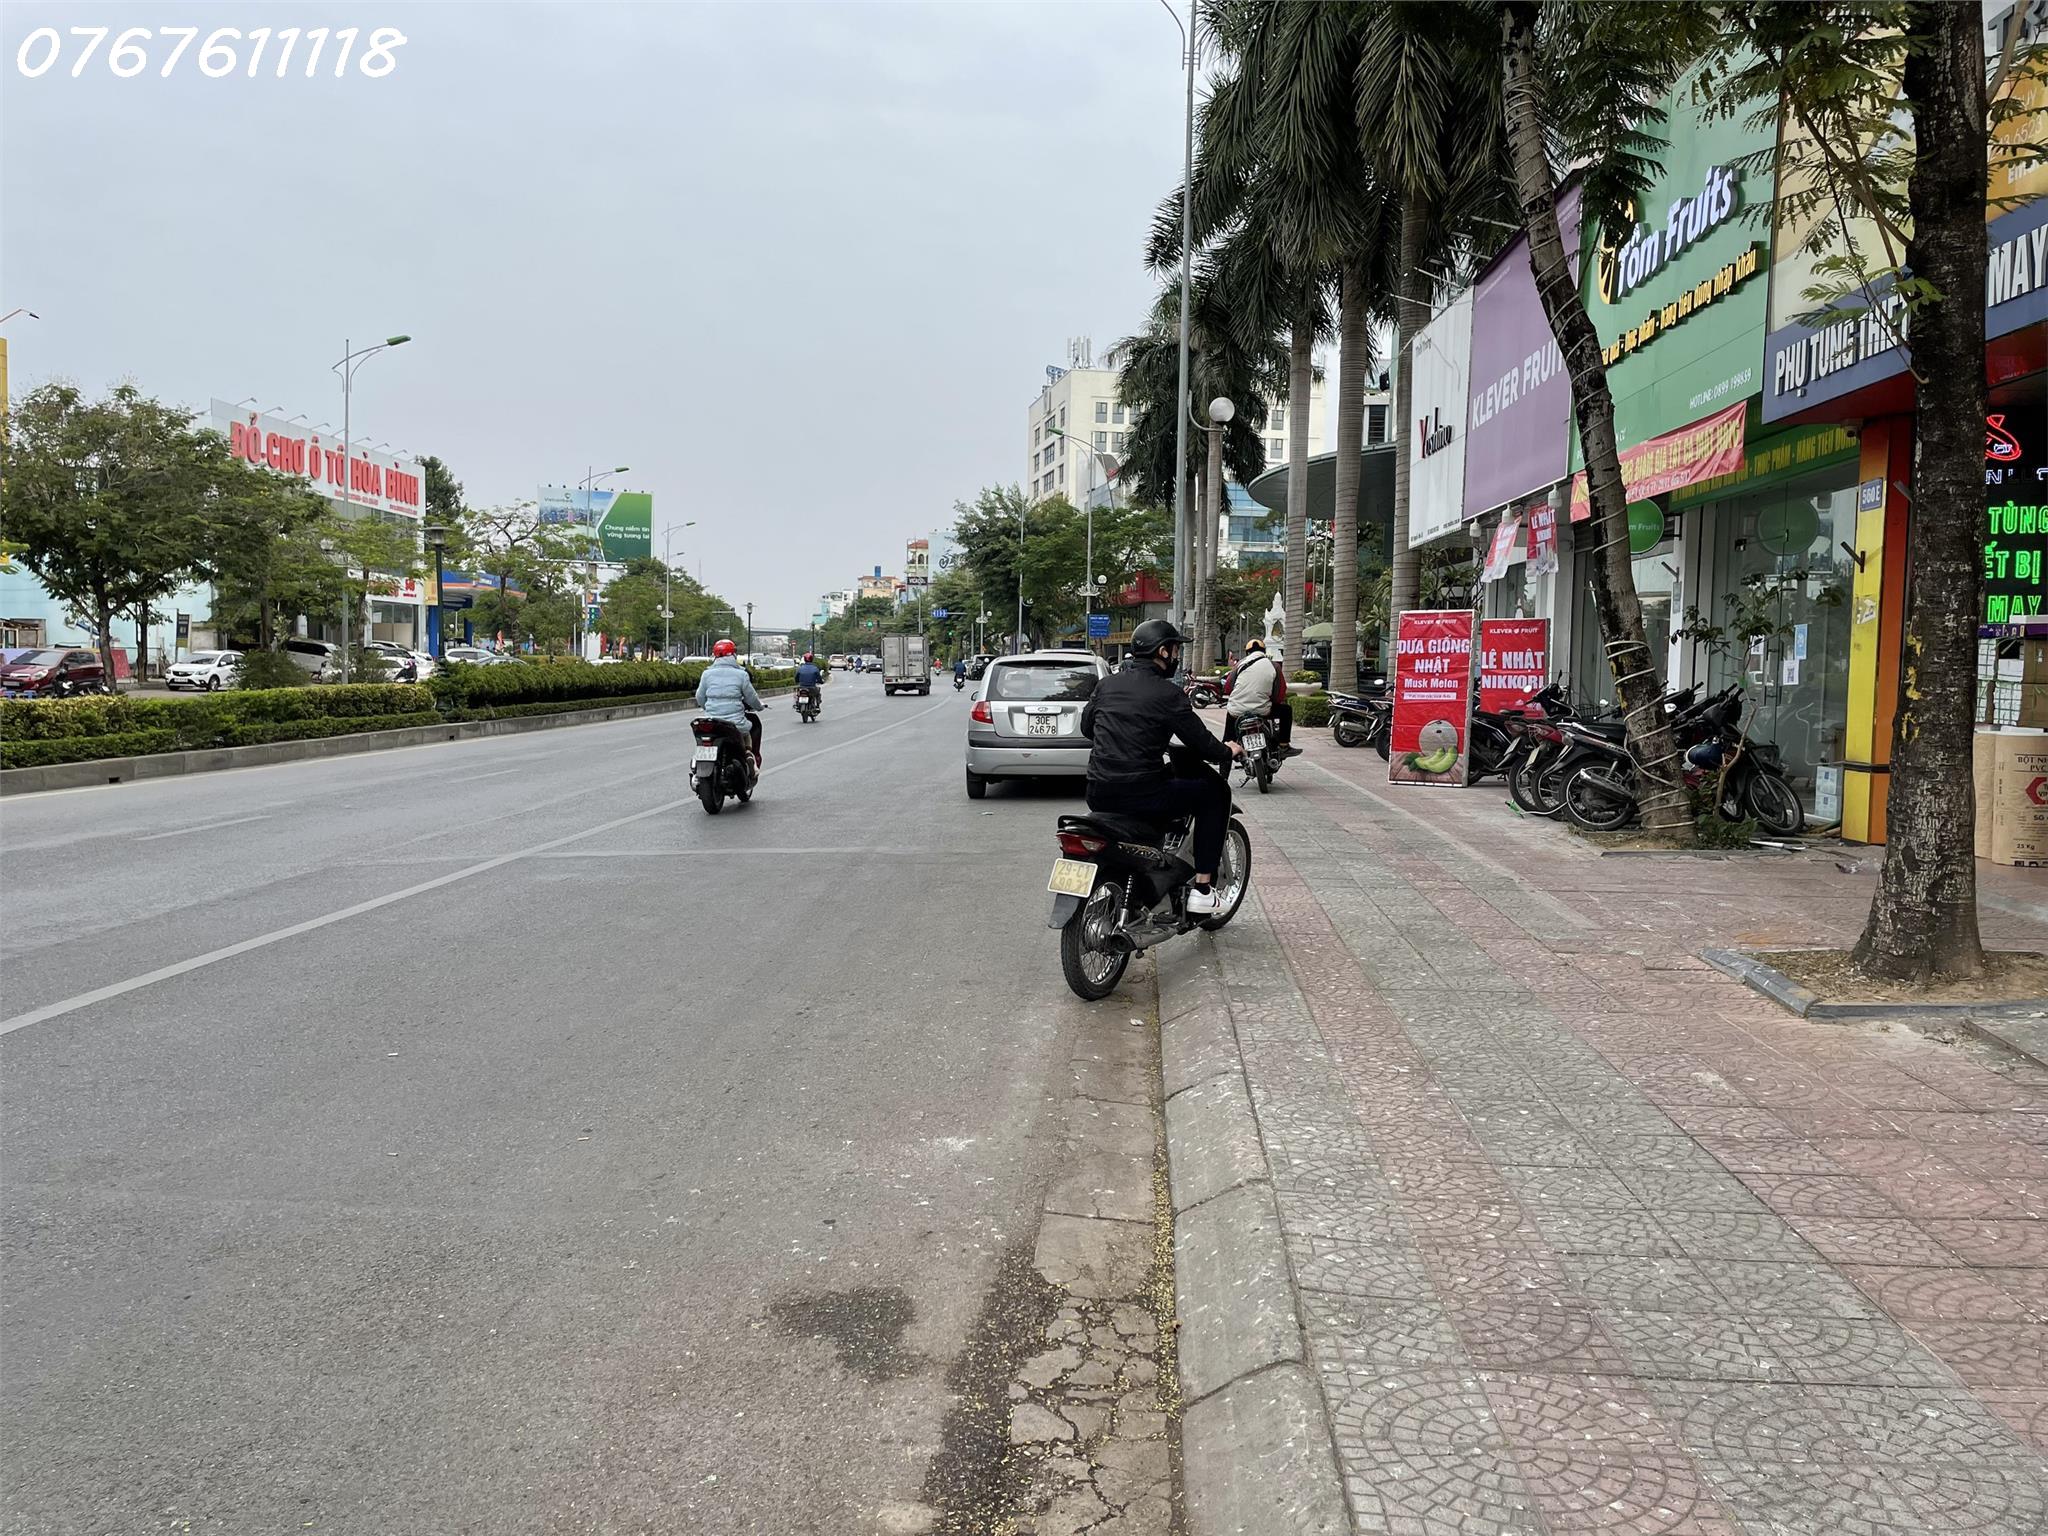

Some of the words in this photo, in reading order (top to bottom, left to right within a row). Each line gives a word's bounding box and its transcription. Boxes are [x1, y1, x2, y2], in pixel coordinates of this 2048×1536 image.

[1616, 222, 1661, 298] Tôm
[1664, 165, 1734, 262] Fruits
[1713, 263, 1734, 296] nhập
[1735, 240, 1757, 282] khẩu
[1988, 223, 2048, 308] MAY
[1774, 337, 1808, 397] PHỤ
[1471, 366, 1519, 431] KLEVER
[350, 450, 383, 497] HÒA
[385, 460, 419, 506] BÌNH
[604, 524, 624, 533] Chung
[1987, 500, 2048, 535] TÙNG
[2015, 550, 2042, 585] BỊ
[1987, 595, 2042, 624] MAY
[1397, 639, 1425, 655] DƯA
[1427, 634, 1471, 654] GIỐNG
[1414, 655, 1451, 676] NHẬT
[1481, 649, 1497, 669] LÊ
[1501, 648, 1545, 673] NHẬT
[1404, 677, 1428, 689] Musk
[1430, 677, 1459, 689] Melon
[1481, 674, 1544, 690] NIKKORI
[1029, 725, 1057, 735] 24678
[1035, 715, 1051, 725] 30E
[2018, 756, 2034, 765] BỘT
